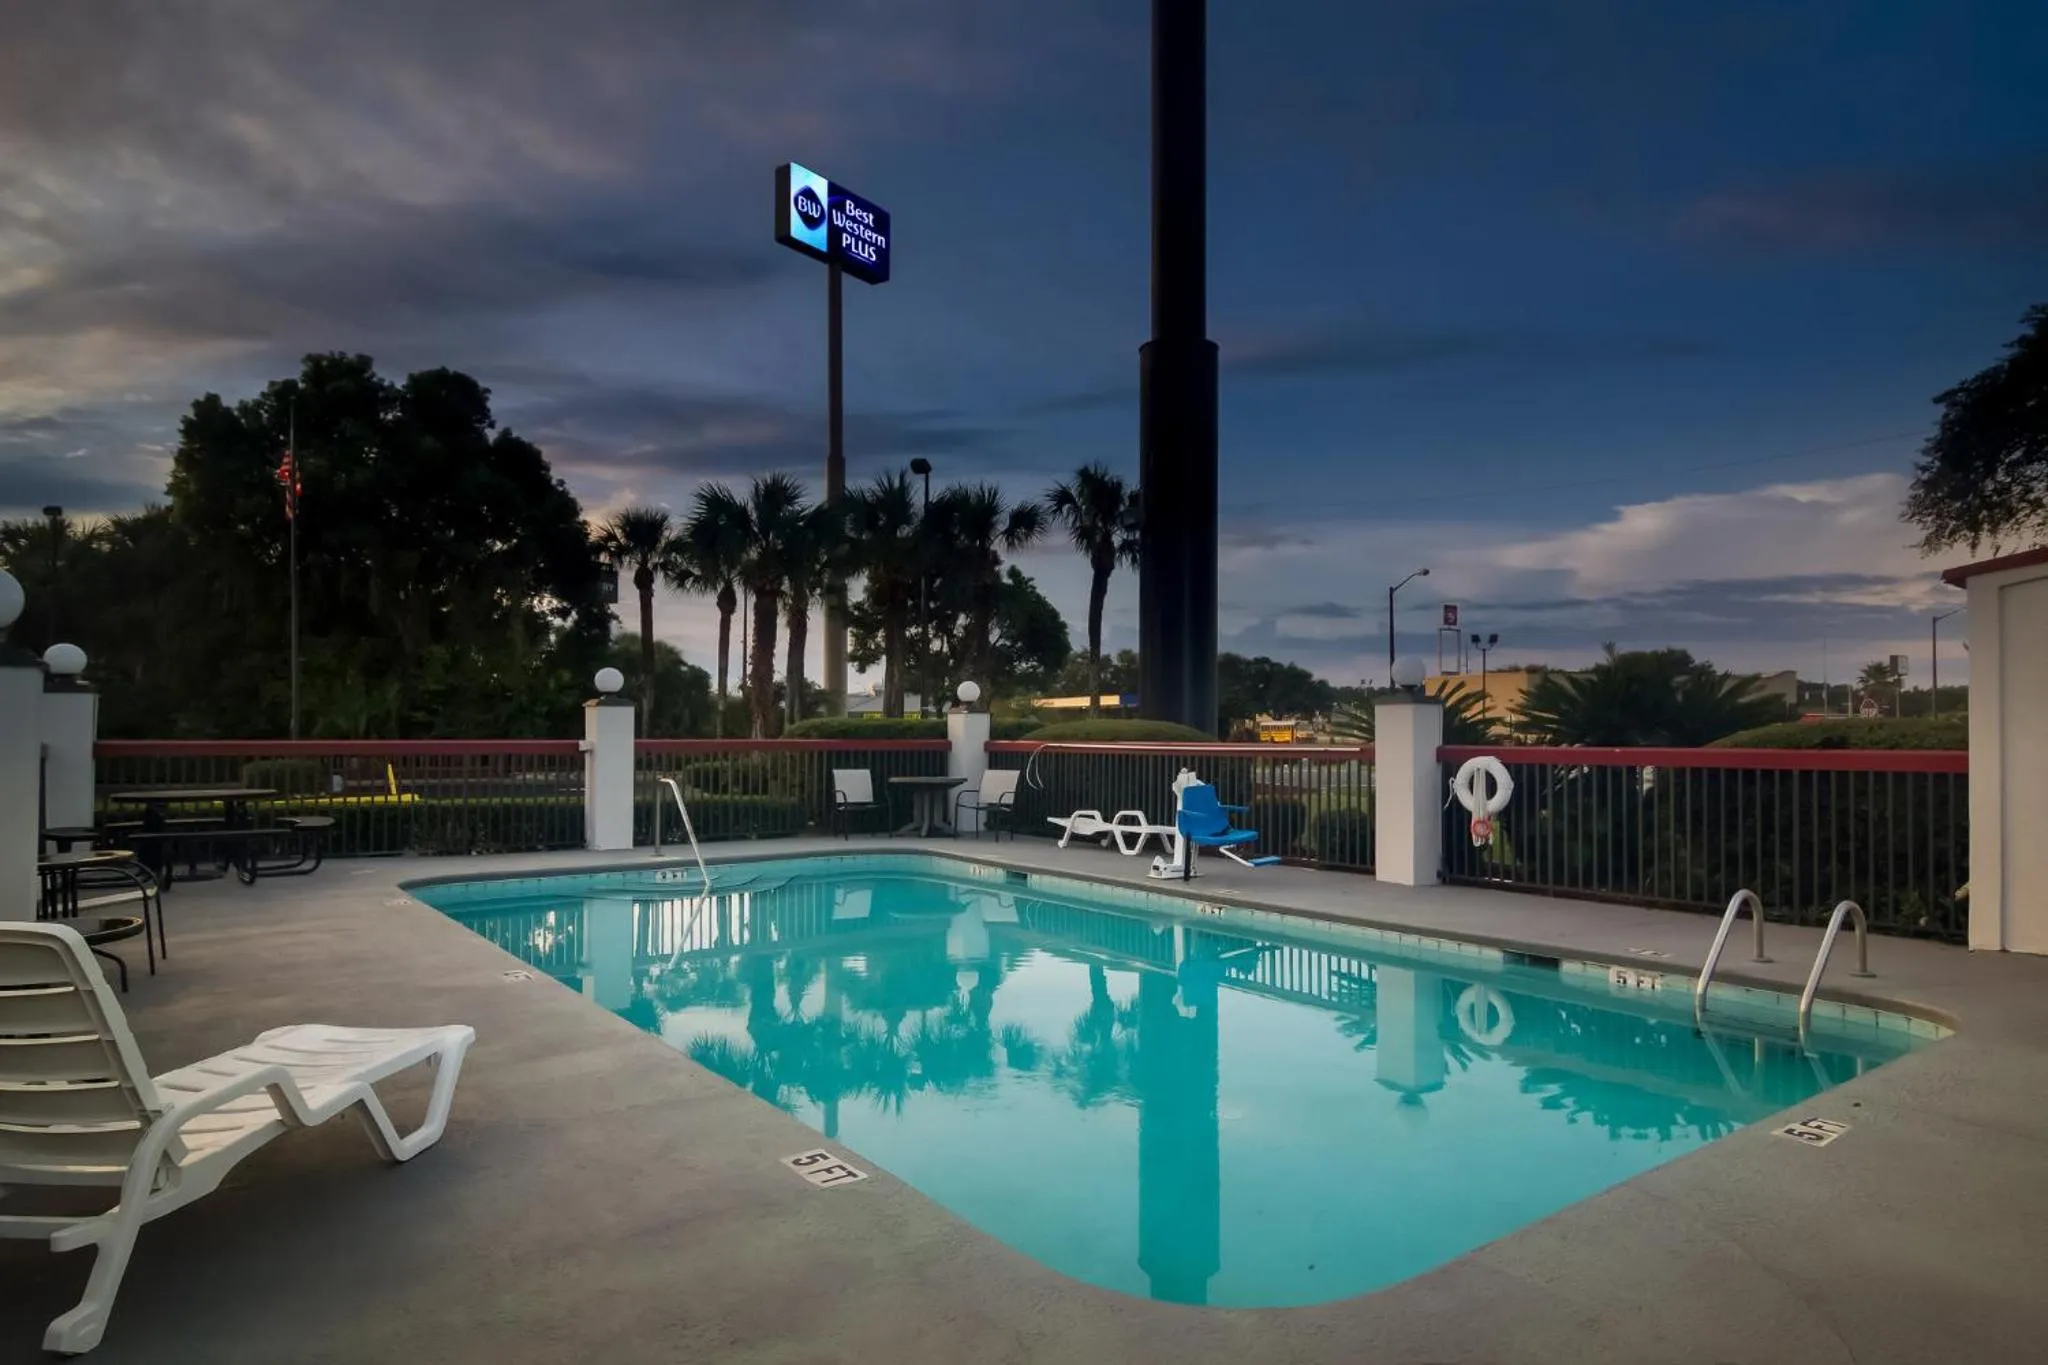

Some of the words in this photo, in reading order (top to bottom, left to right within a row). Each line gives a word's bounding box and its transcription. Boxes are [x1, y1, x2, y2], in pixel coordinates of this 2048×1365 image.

[798, 196, 821, 218] BW
[846, 199, 875, 227] Best
[832, 209, 886, 249] Western
[842, 232, 876, 262] PLUS
[1783, 1128, 1824, 1141] 5
[1800, 1117, 1847, 1134] FT
[791, 1152, 831, 1166] 5
[807, 1164, 859, 1183] FT
